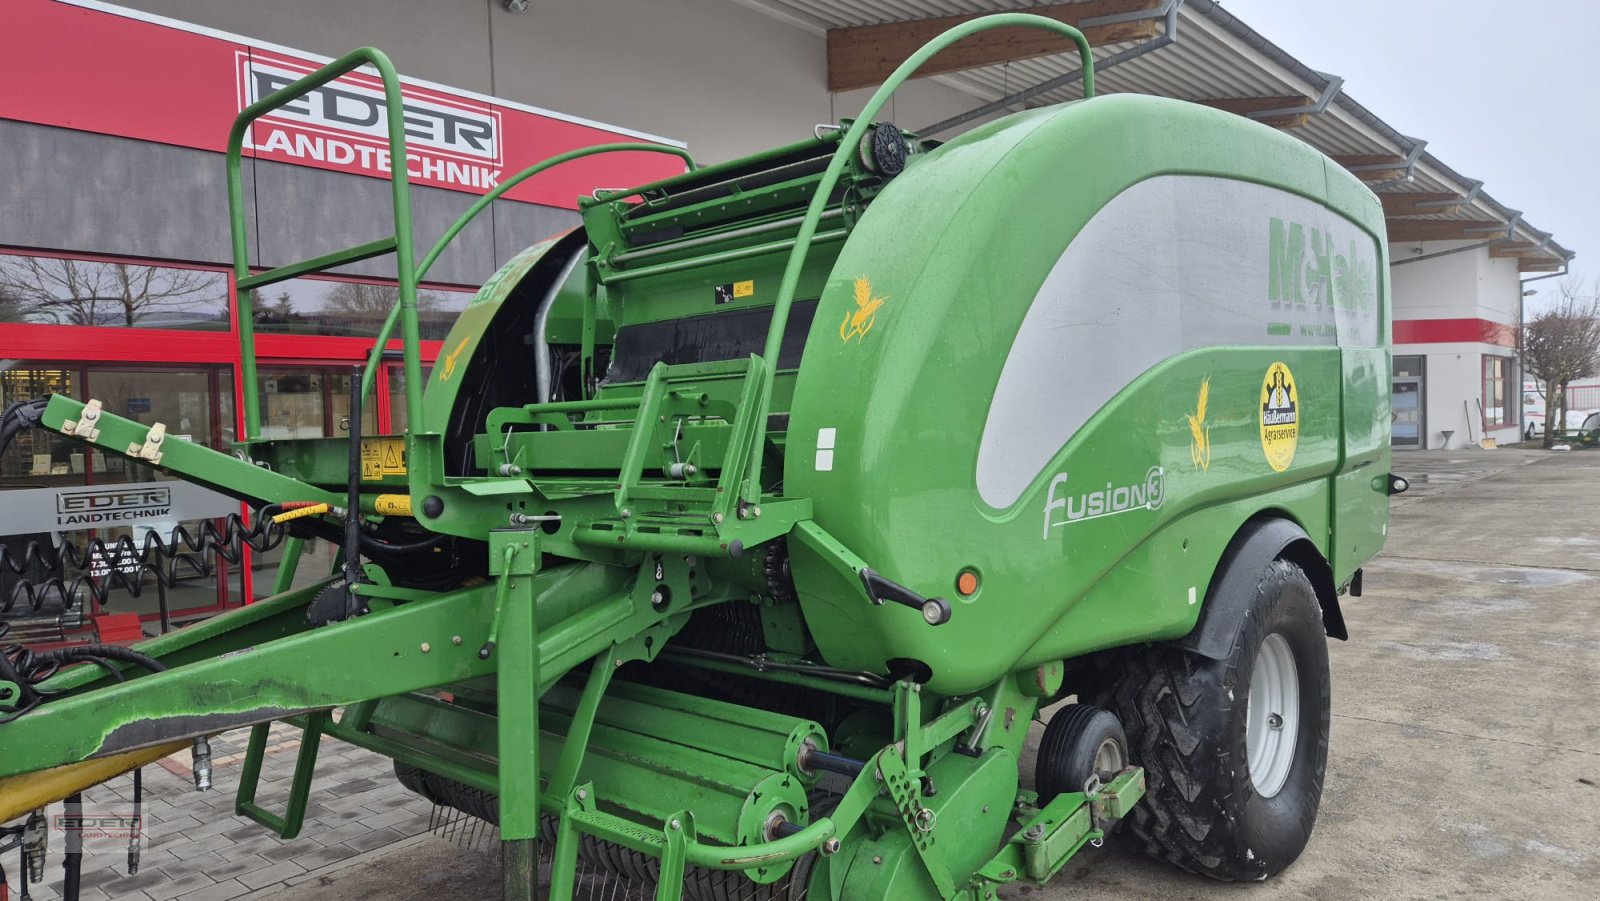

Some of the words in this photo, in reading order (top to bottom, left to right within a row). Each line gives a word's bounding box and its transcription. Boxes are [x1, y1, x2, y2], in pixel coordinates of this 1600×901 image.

[251, 70, 492, 151] EDER
[242, 119, 502, 189] LANDTECHNIK
[1264, 410, 1296, 425] Häußermann
[1264, 428, 1296, 445] Agrarservice
[64, 491, 167, 510] EDER
[57, 508, 170, 525] LANDTECHNIK
